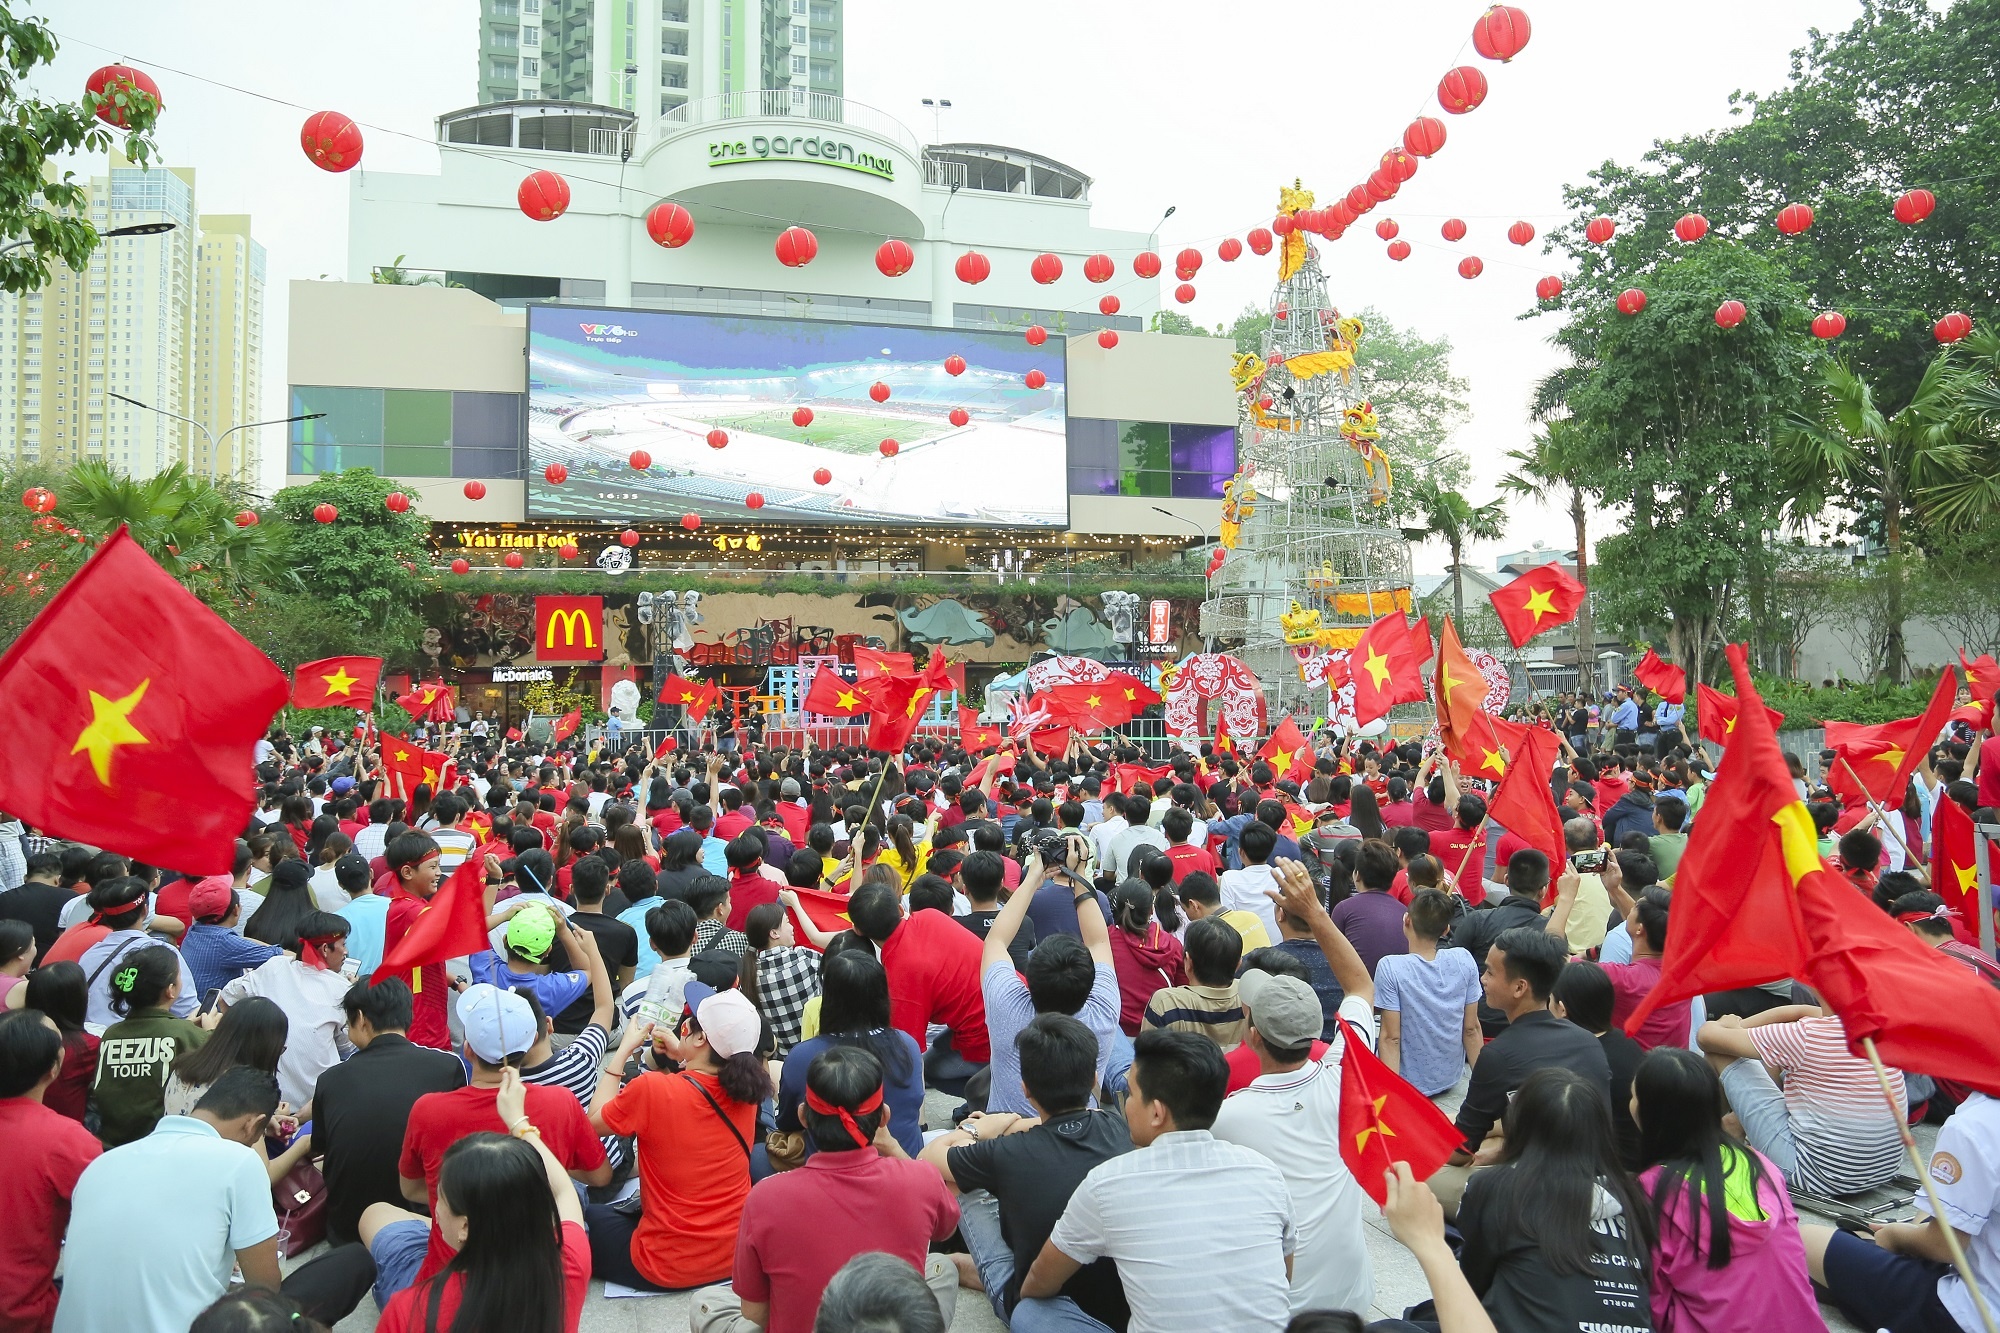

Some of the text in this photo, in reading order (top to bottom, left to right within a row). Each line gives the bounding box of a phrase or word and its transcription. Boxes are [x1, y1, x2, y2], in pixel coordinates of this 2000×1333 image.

[709, 135, 894, 175] the garden mall
[598, 492, 639, 500] 16:35
[463, 532, 579, 548] Yau Hau Fook
[1161, 645, 1178, 653] CHA
[492, 669, 553, 682] McDonald's
[94, 1037, 176, 1090] YEEZUS
[111, 1064, 151, 1077] TOUR
[1594, 1280, 1616, 1288] TIME
